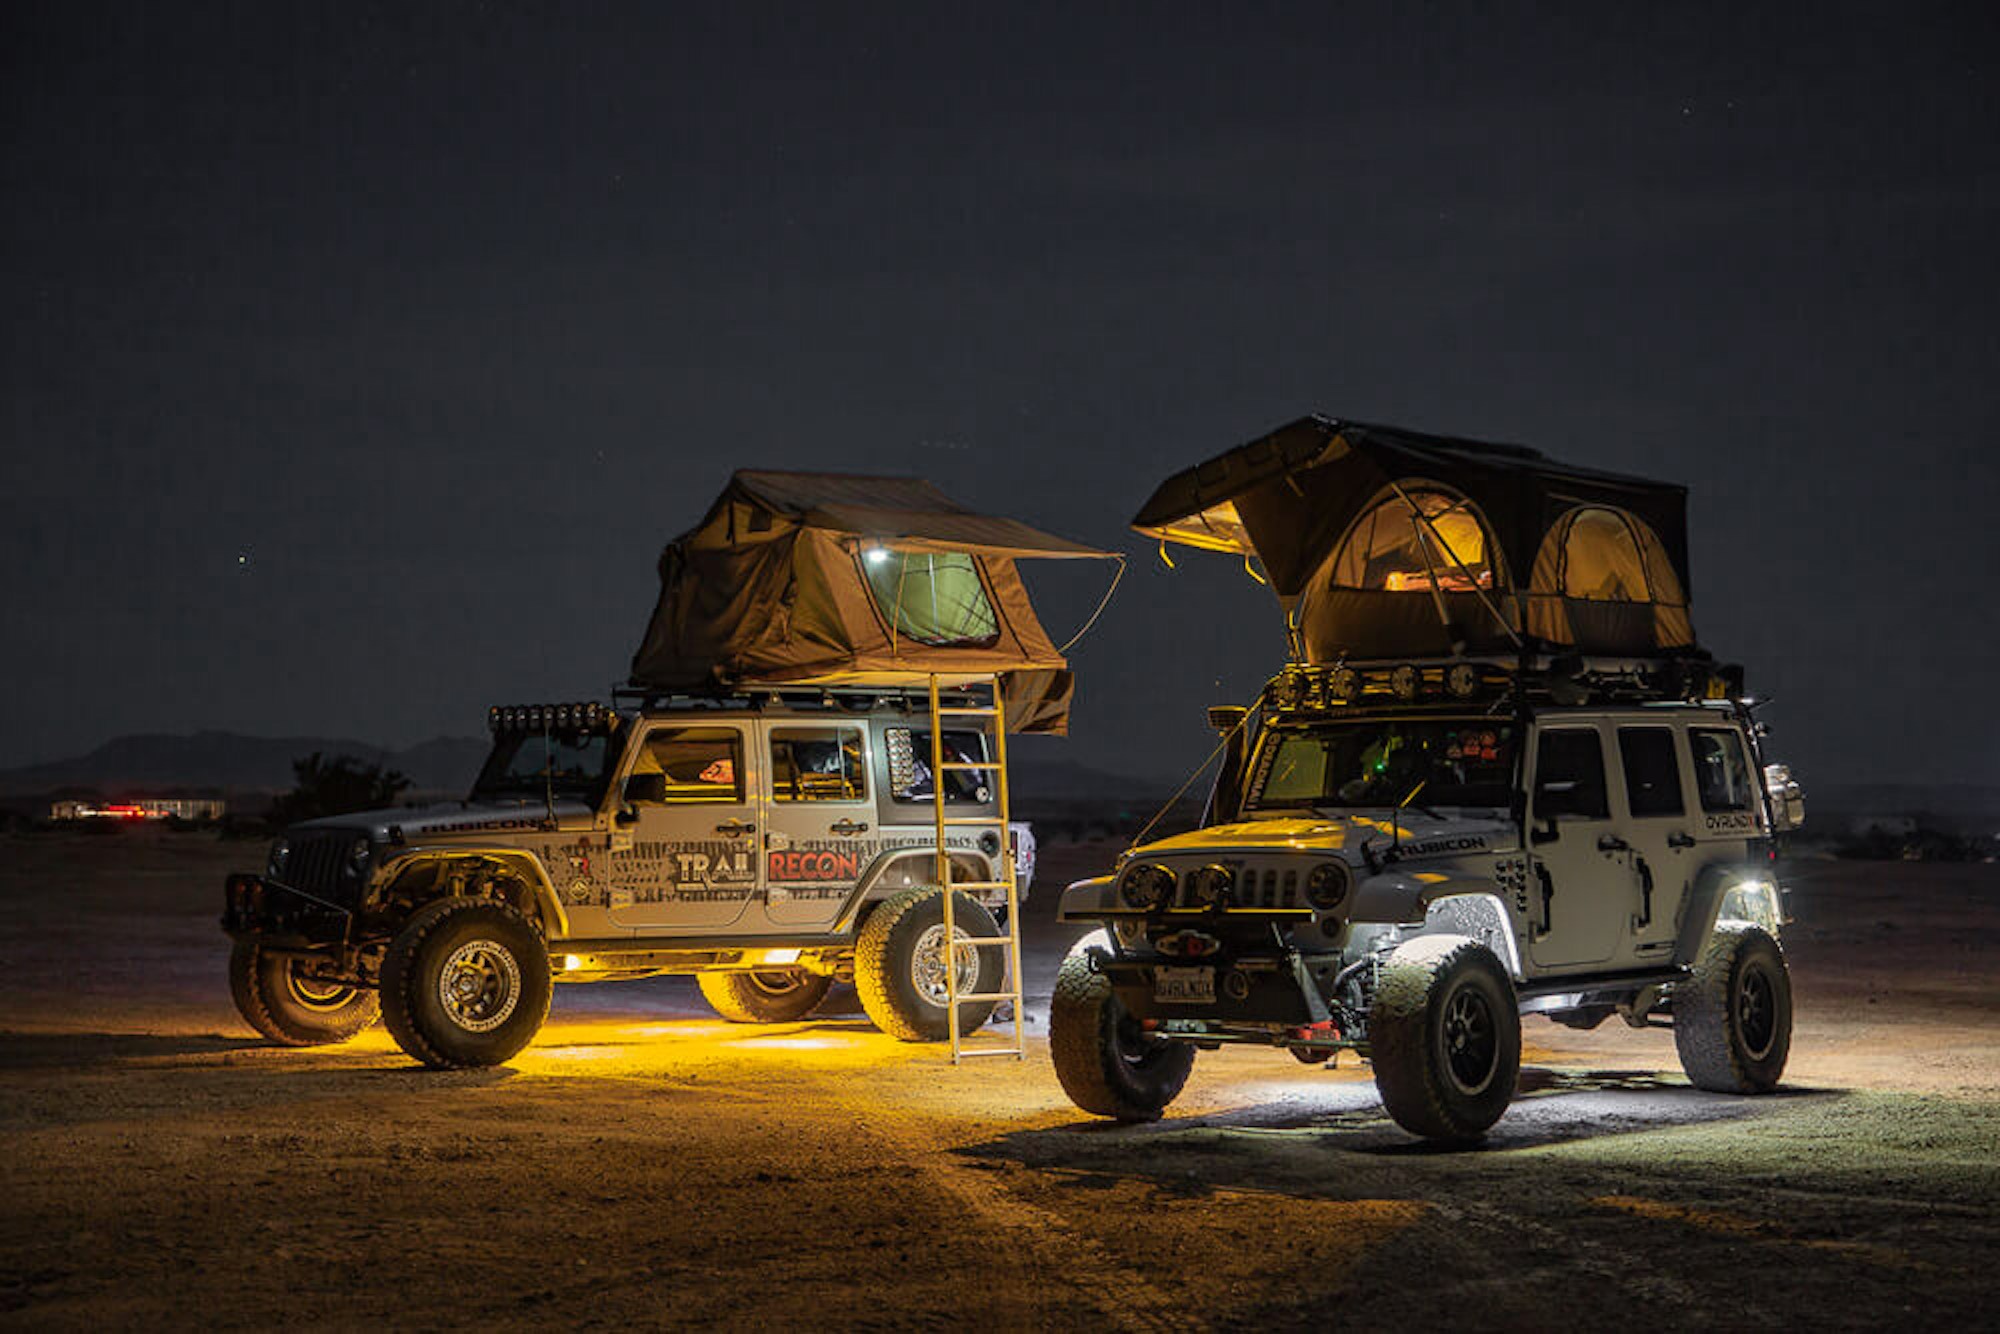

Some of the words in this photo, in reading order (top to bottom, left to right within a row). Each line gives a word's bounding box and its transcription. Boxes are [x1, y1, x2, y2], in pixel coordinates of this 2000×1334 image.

[421, 820, 537, 832] RUBICON
[1402, 837, 1486, 856] RUBICON
[676, 852, 754, 889] TRAIL
[770, 851, 858, 880] RECON
